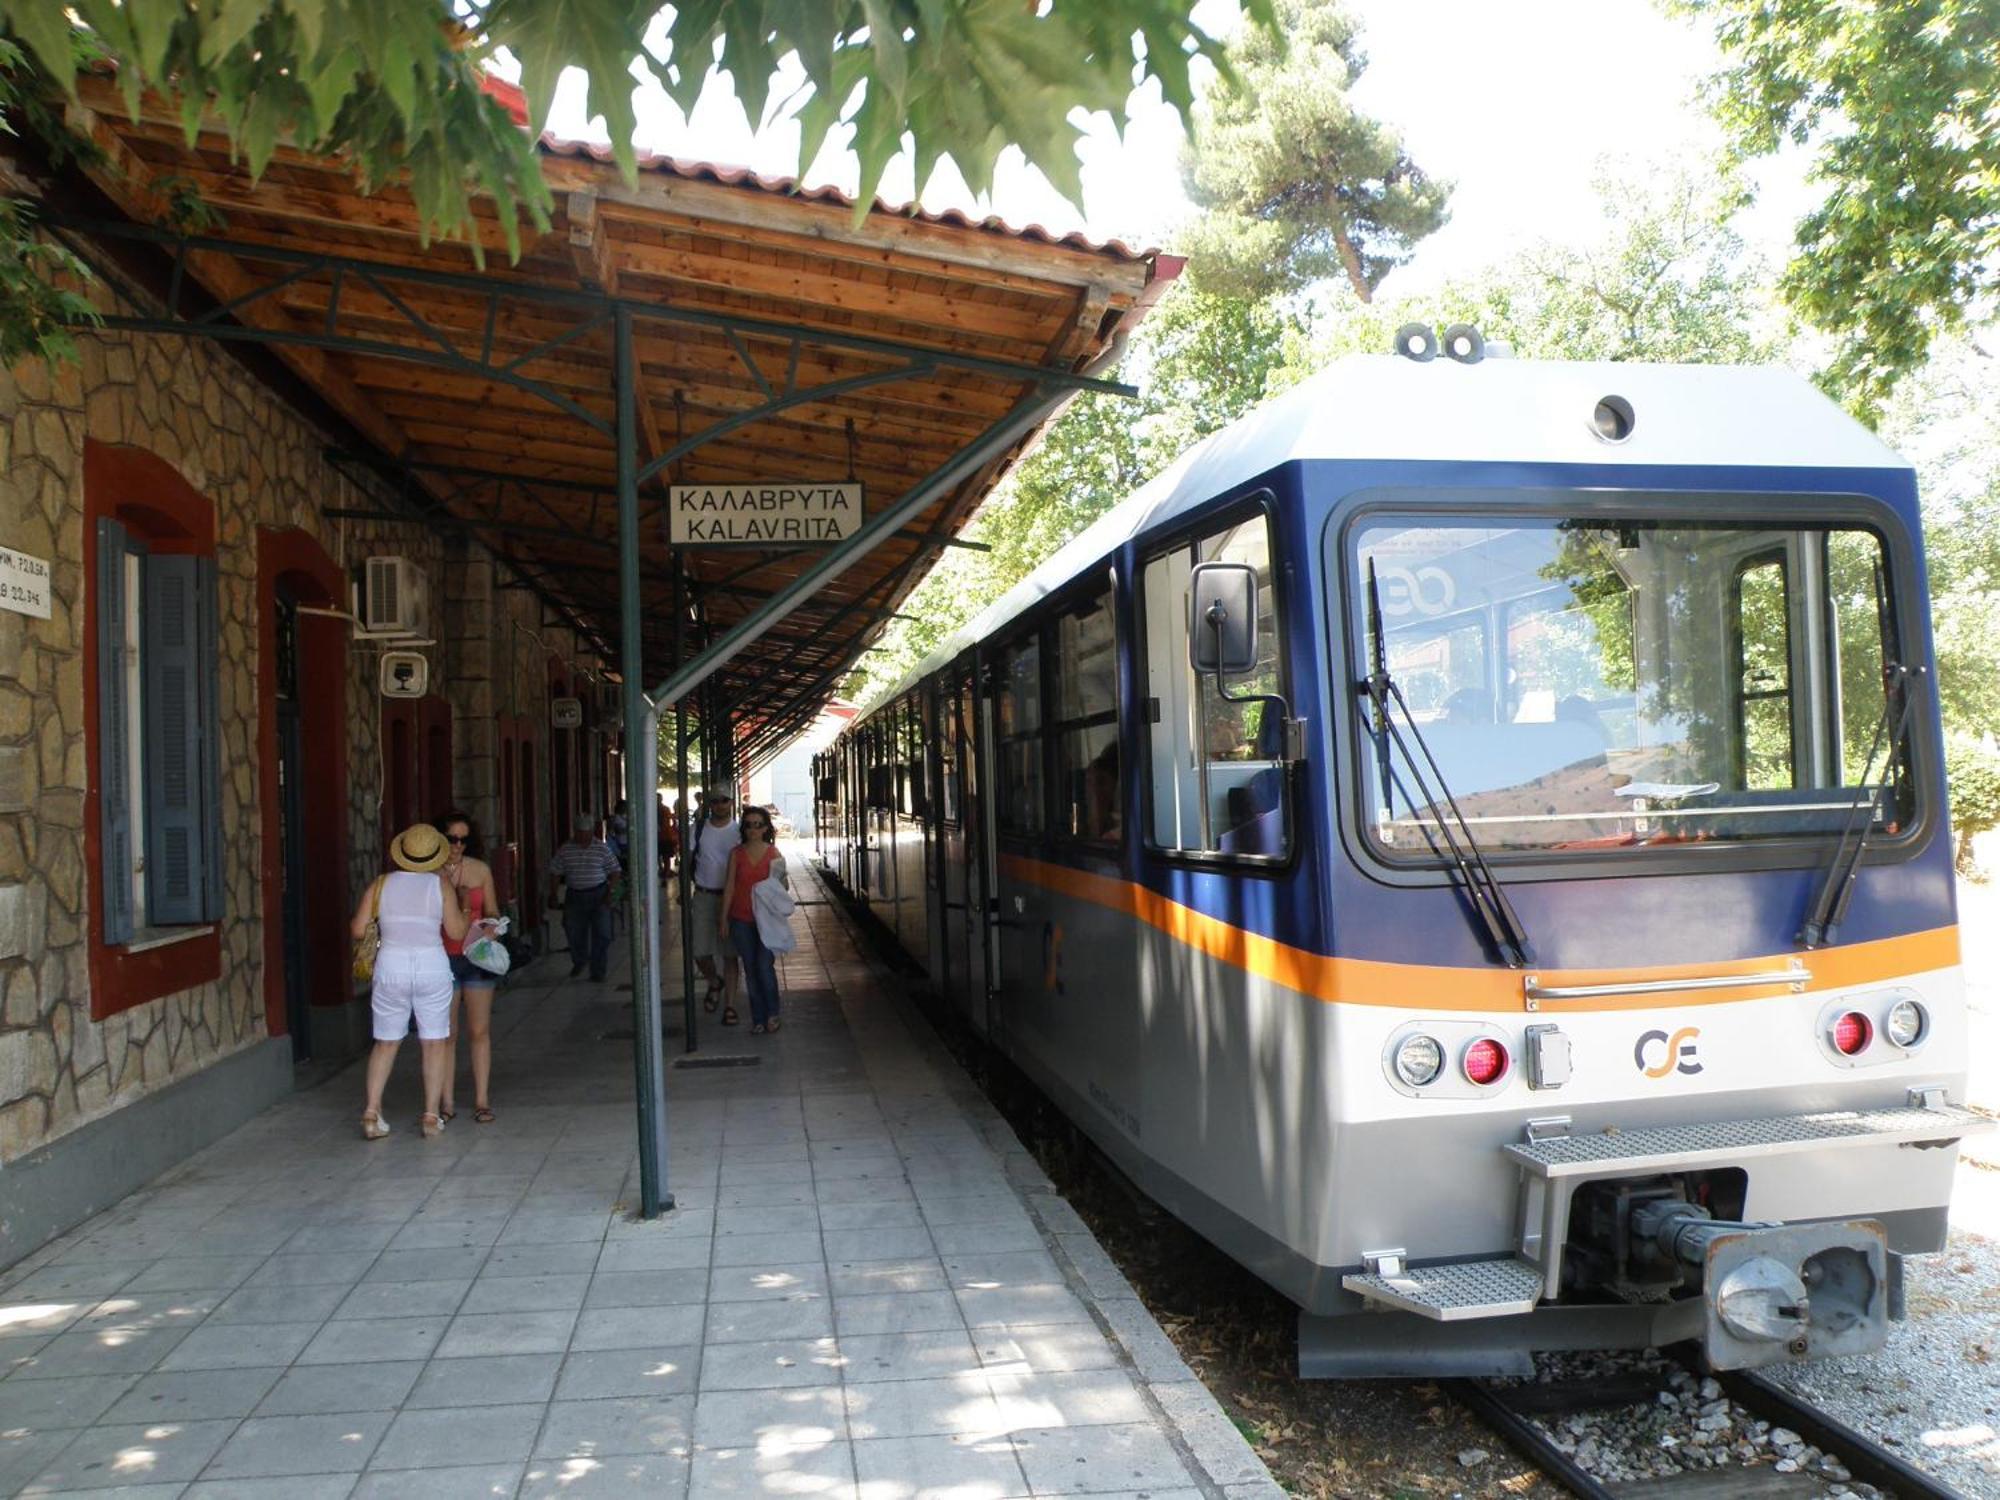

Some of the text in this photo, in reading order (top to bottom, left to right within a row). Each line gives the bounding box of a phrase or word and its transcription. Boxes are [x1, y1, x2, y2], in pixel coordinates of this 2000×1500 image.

[679, 489, 849, 511] ΚΑΛΑΒΡΥΤΑ
[688, 518, 842, 540] KALAVRITA
[556, 704, 577, 718] WC
